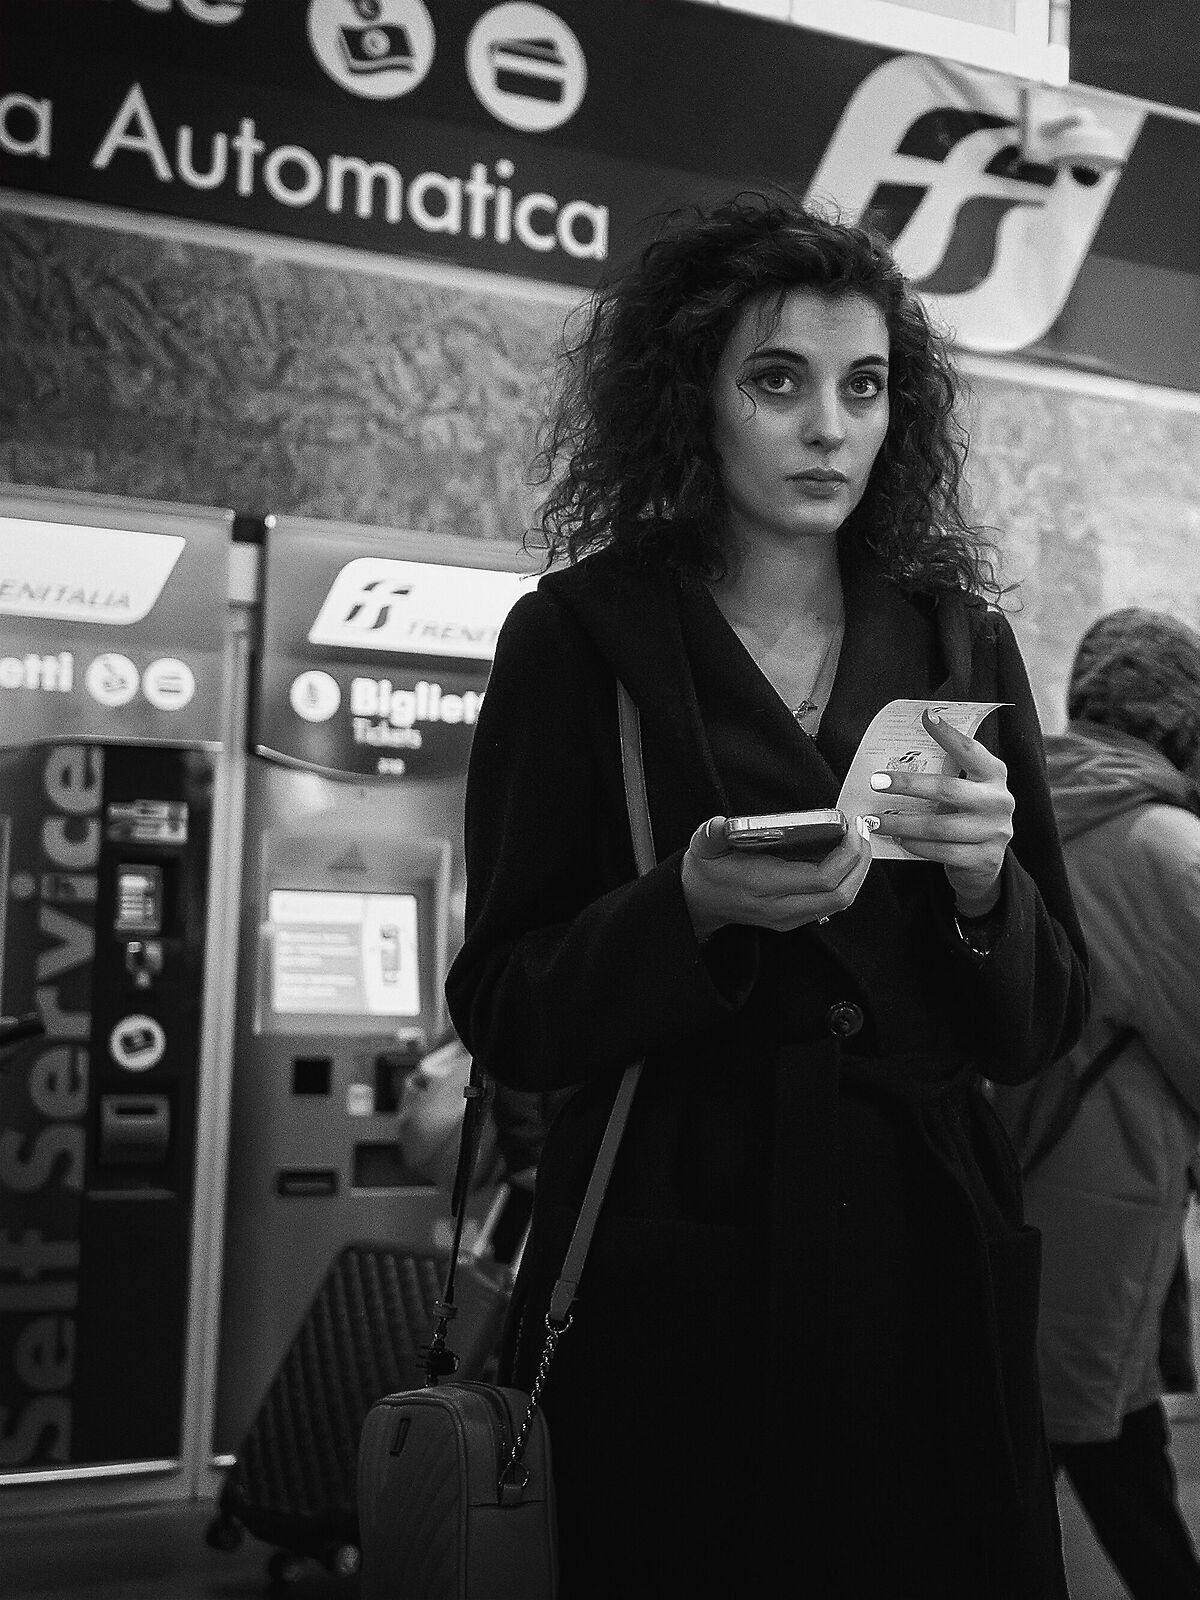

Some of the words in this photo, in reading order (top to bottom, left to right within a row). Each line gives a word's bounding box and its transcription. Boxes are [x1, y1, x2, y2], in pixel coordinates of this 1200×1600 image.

[91, 81, 609, 260] Automatica
[350, 677, 485, 728] Bigliet
[0, 744, 104, 1192] Service
[0, 1226, 79, 1464] Self
